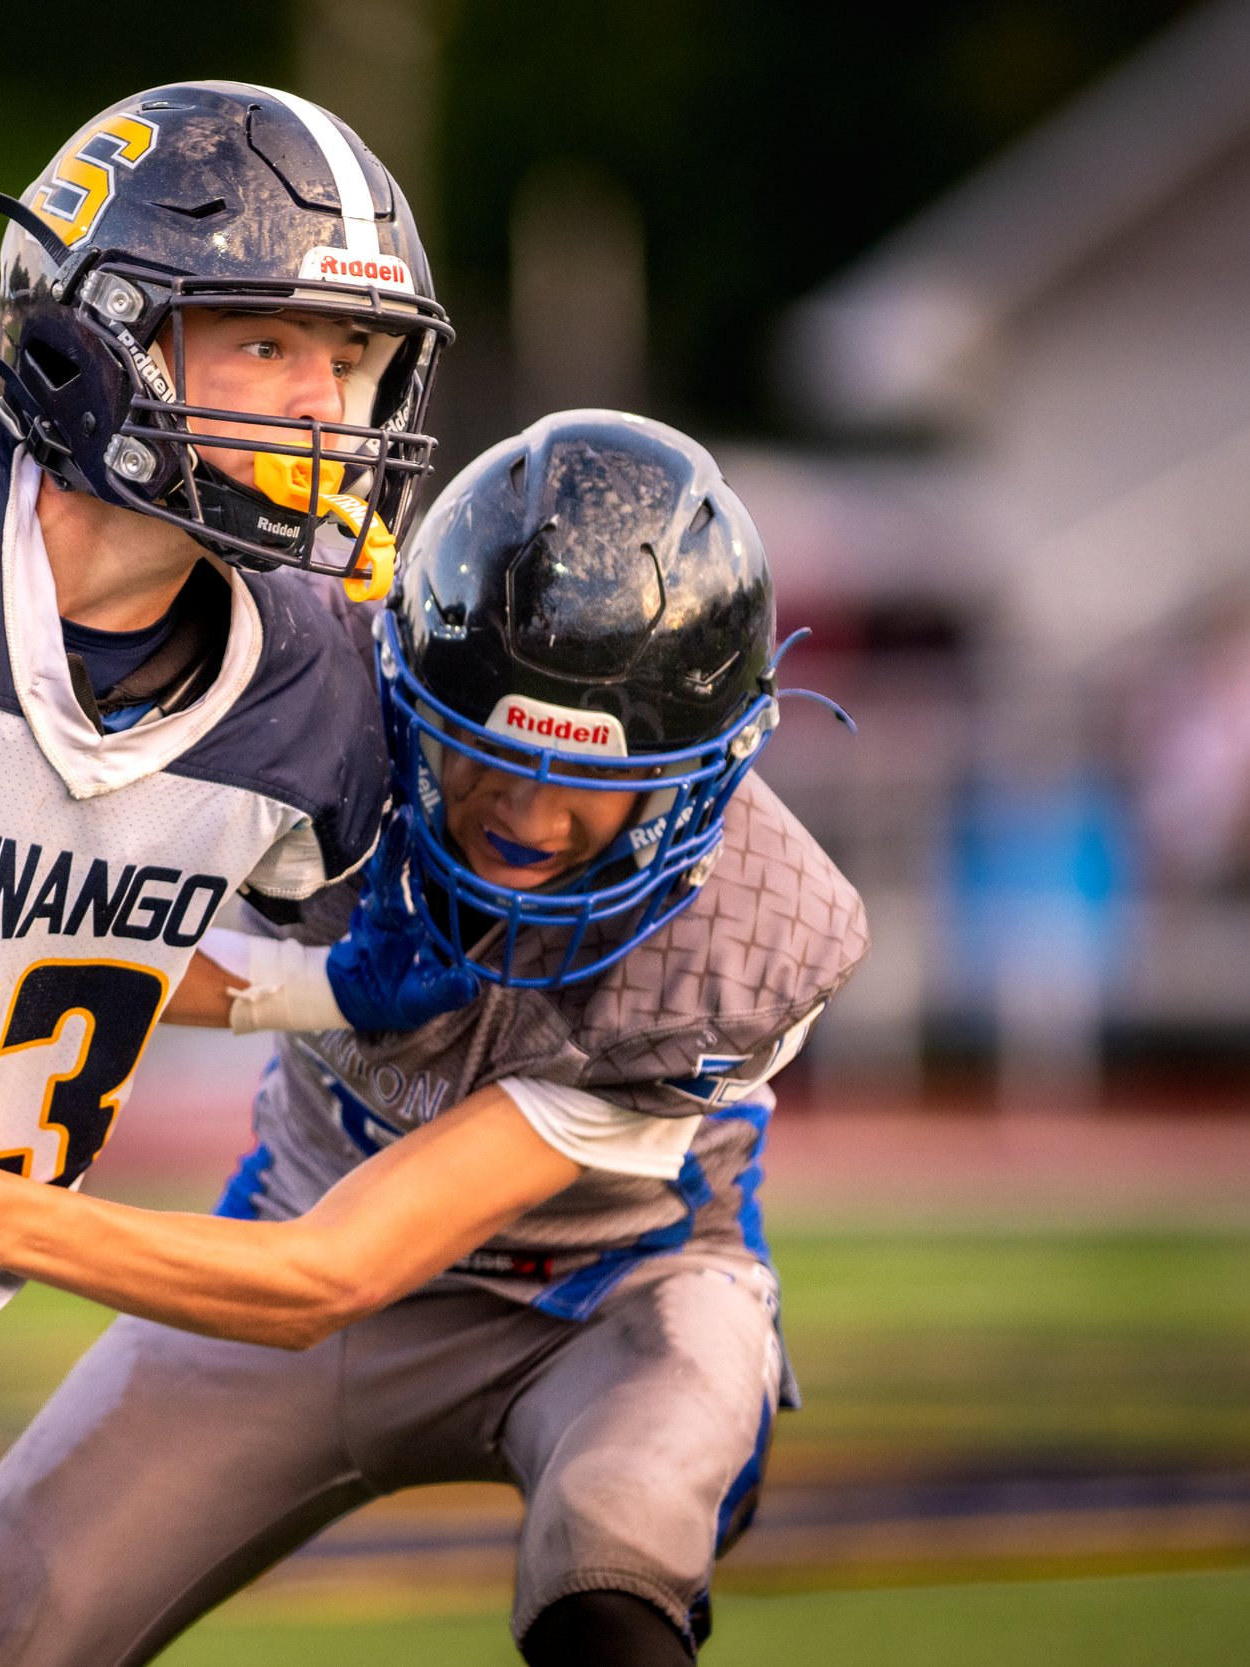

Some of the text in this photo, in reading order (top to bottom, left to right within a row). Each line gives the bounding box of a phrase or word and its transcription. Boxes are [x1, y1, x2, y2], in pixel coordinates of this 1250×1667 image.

[29, 112, 160, 251] S
[320, 255, 405, 284] Riddell
[117, 329, 175, 404] Riddell
[257, 515, 300, 539] Riddell
[506, 704, 610, 745] Riddell
